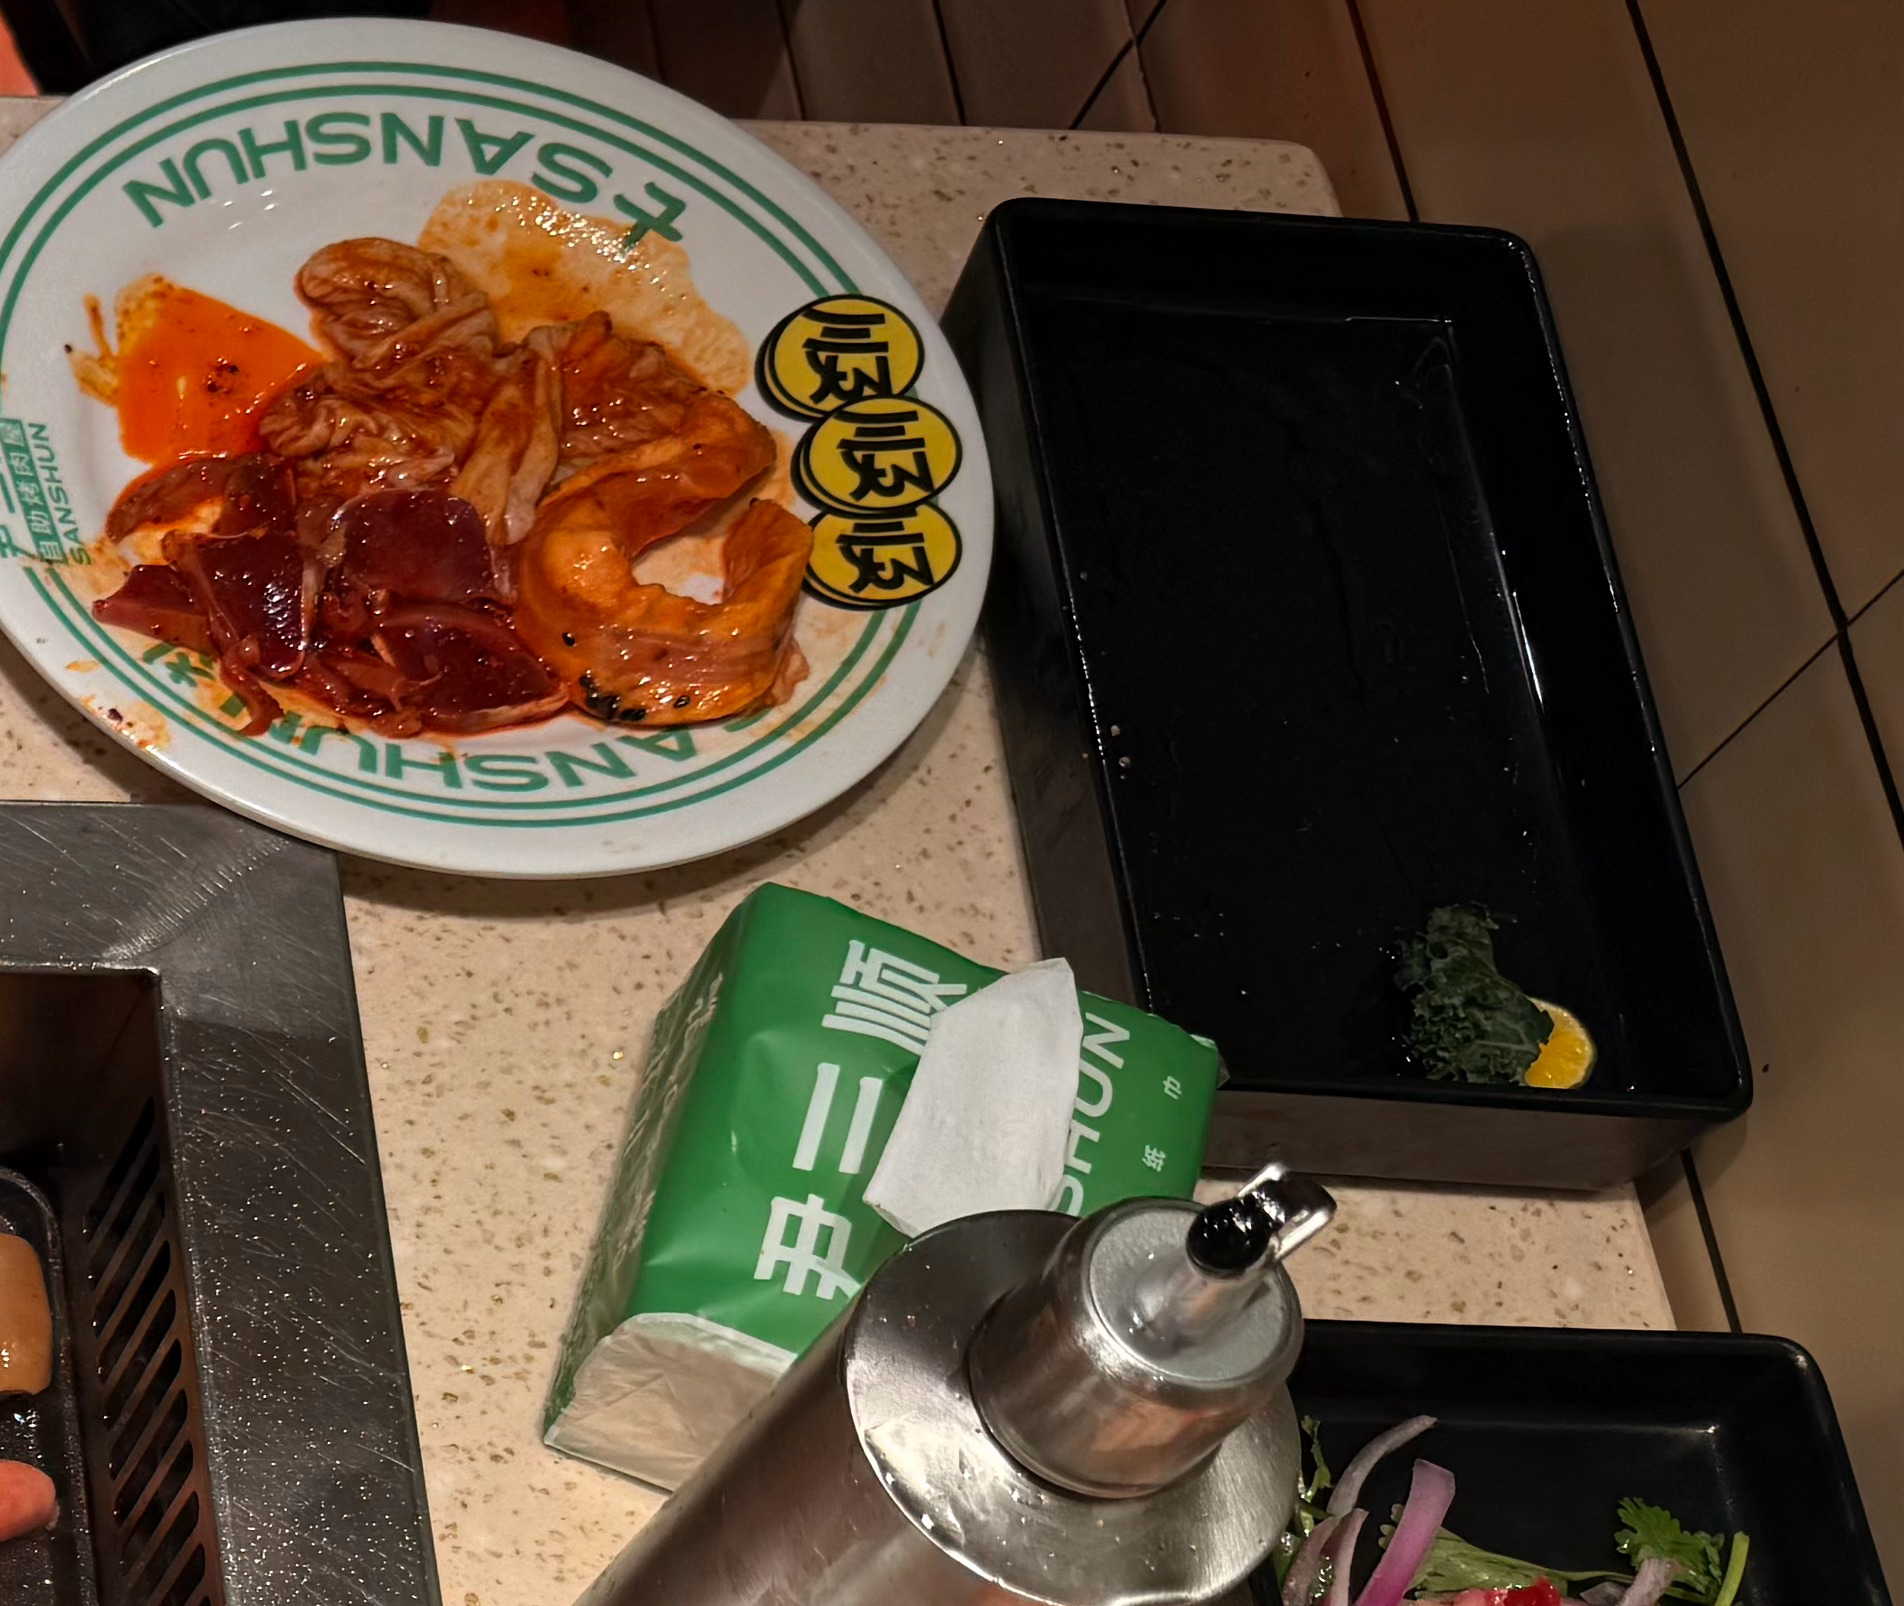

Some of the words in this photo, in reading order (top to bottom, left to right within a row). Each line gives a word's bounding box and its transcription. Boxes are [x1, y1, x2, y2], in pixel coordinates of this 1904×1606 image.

[121, 112, 613, 228] SANSHUN
[28, 422, 91, 566] SANSHUN
[1053, 1011, 1130, 1218] SHUN
